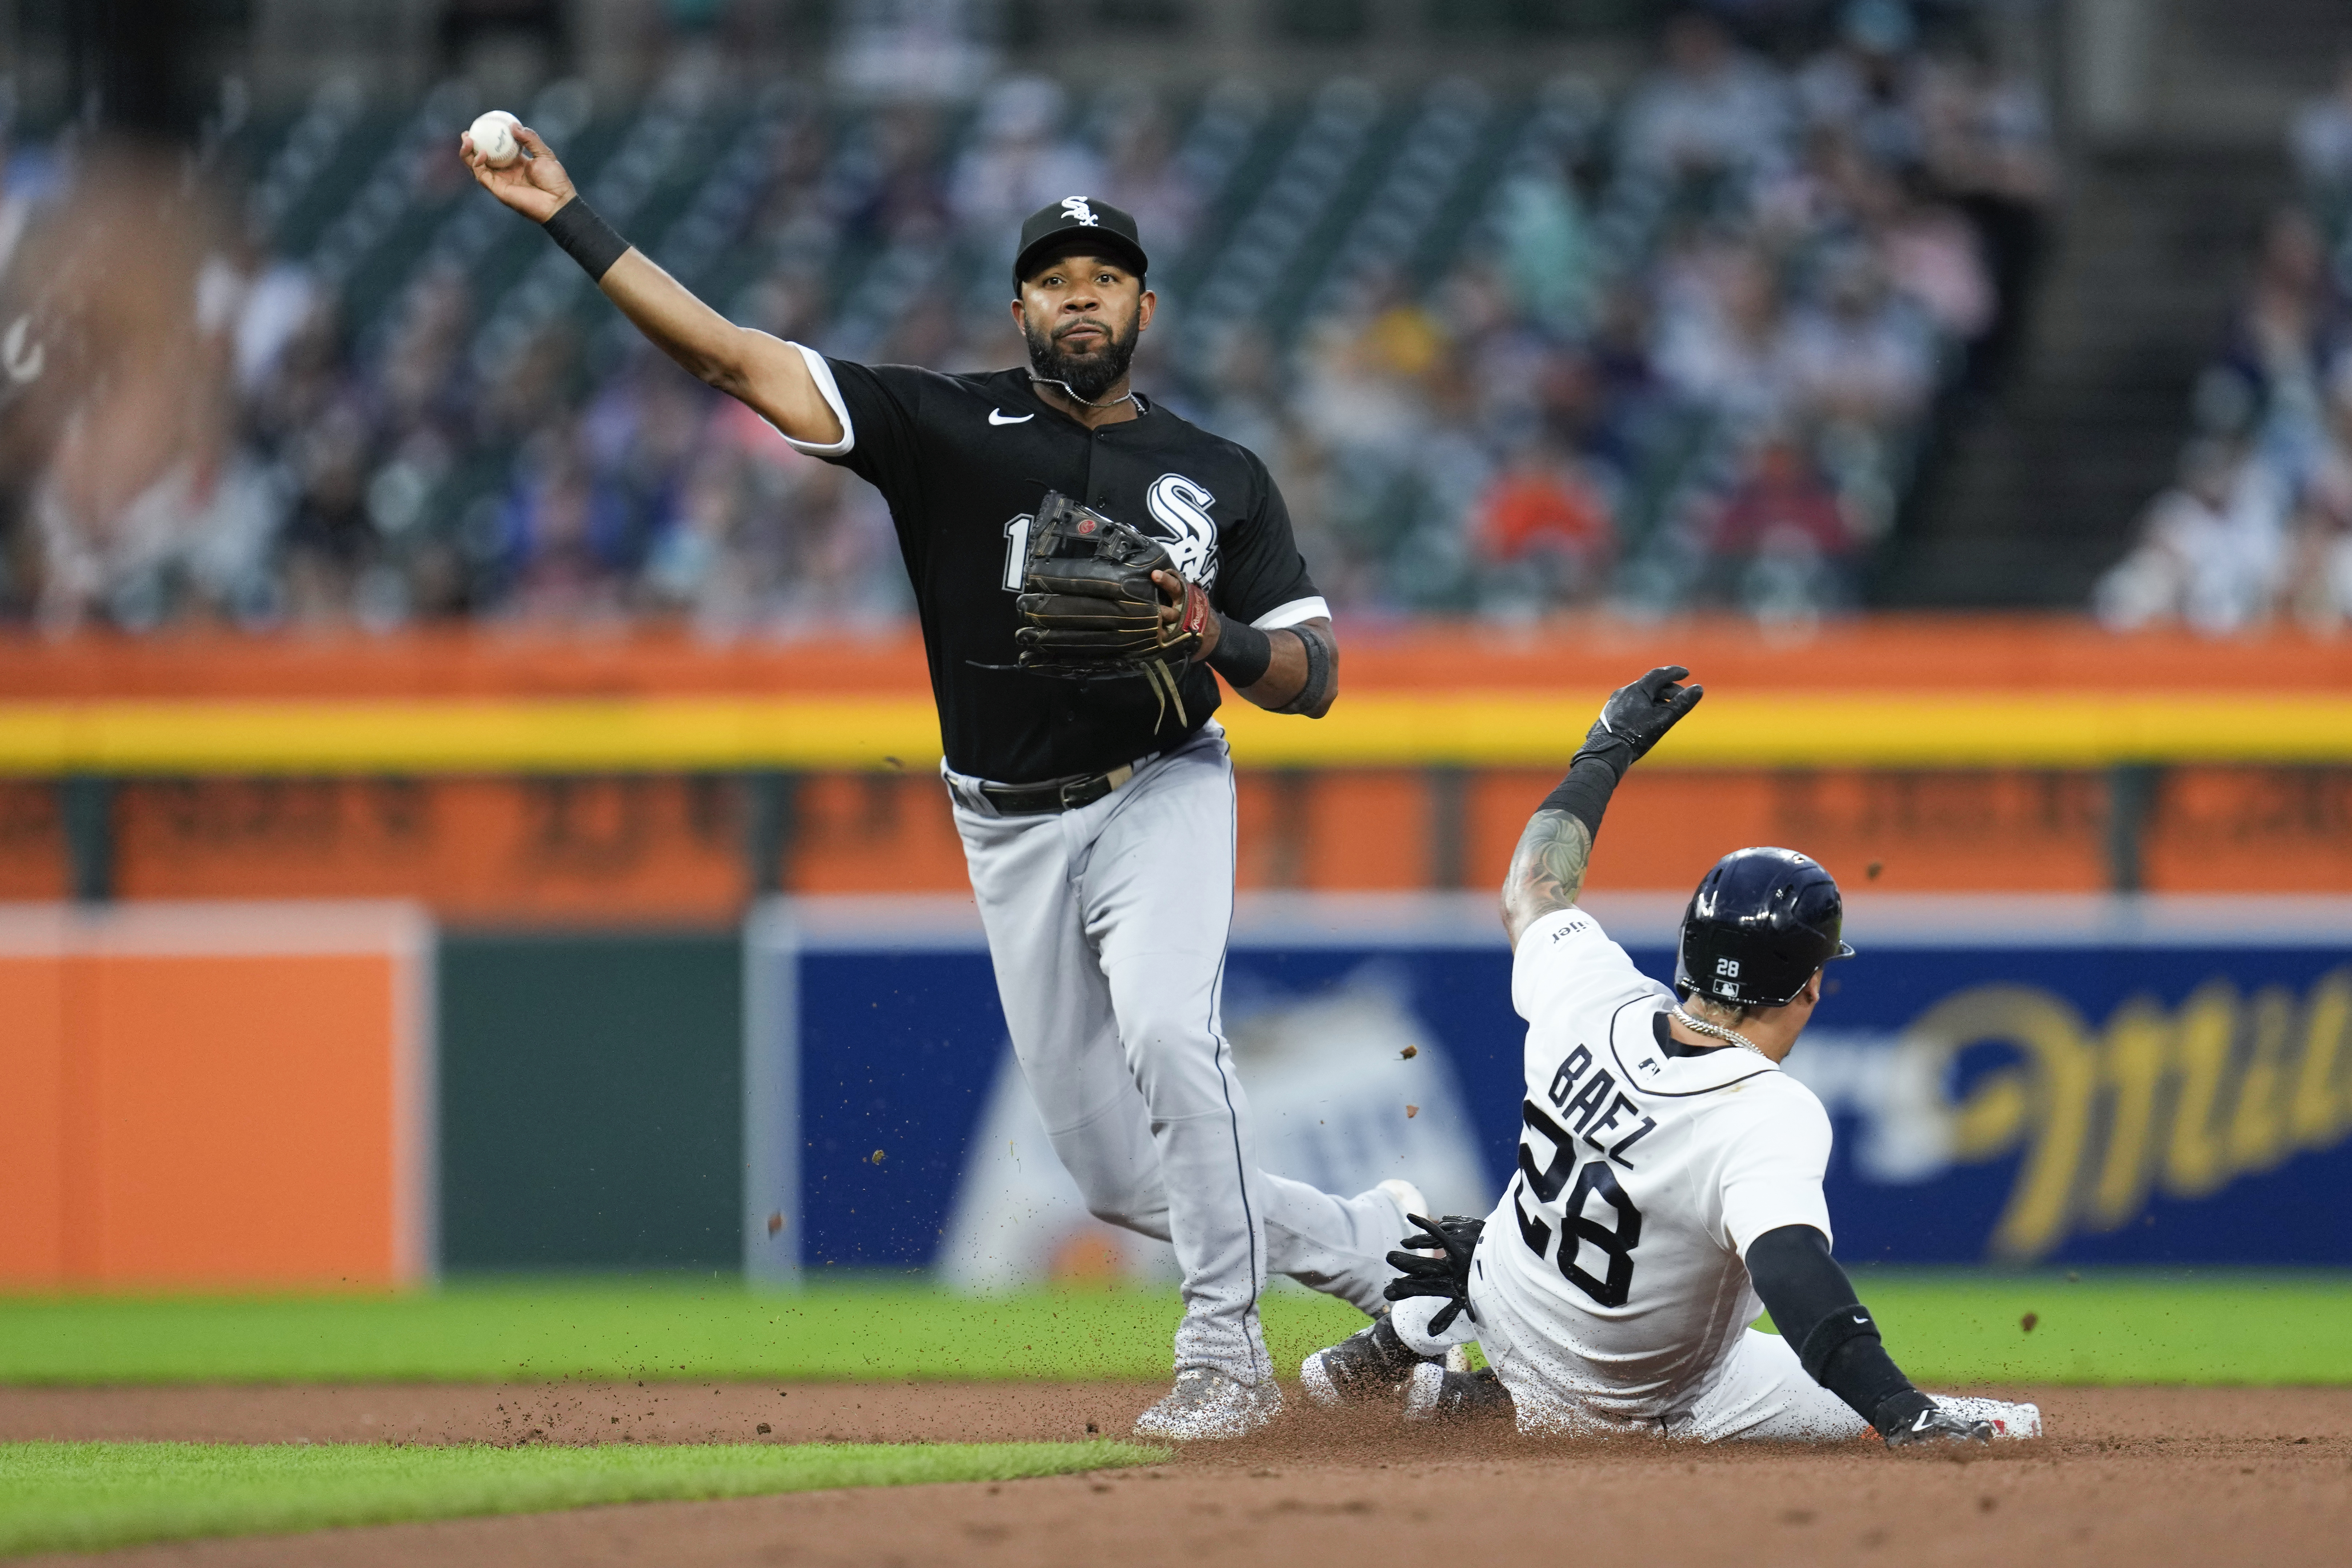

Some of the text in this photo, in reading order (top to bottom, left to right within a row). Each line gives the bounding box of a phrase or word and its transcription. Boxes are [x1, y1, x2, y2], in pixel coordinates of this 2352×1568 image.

[1061, 196, 1098, 226] Sox
[1552, 921, 1590, 944] ijer
[1716, 958, 1740, 978] 28
[1548, 1043, 1657, 1170] BAEZ
[1514, 1092, 1642, 1308] 28
